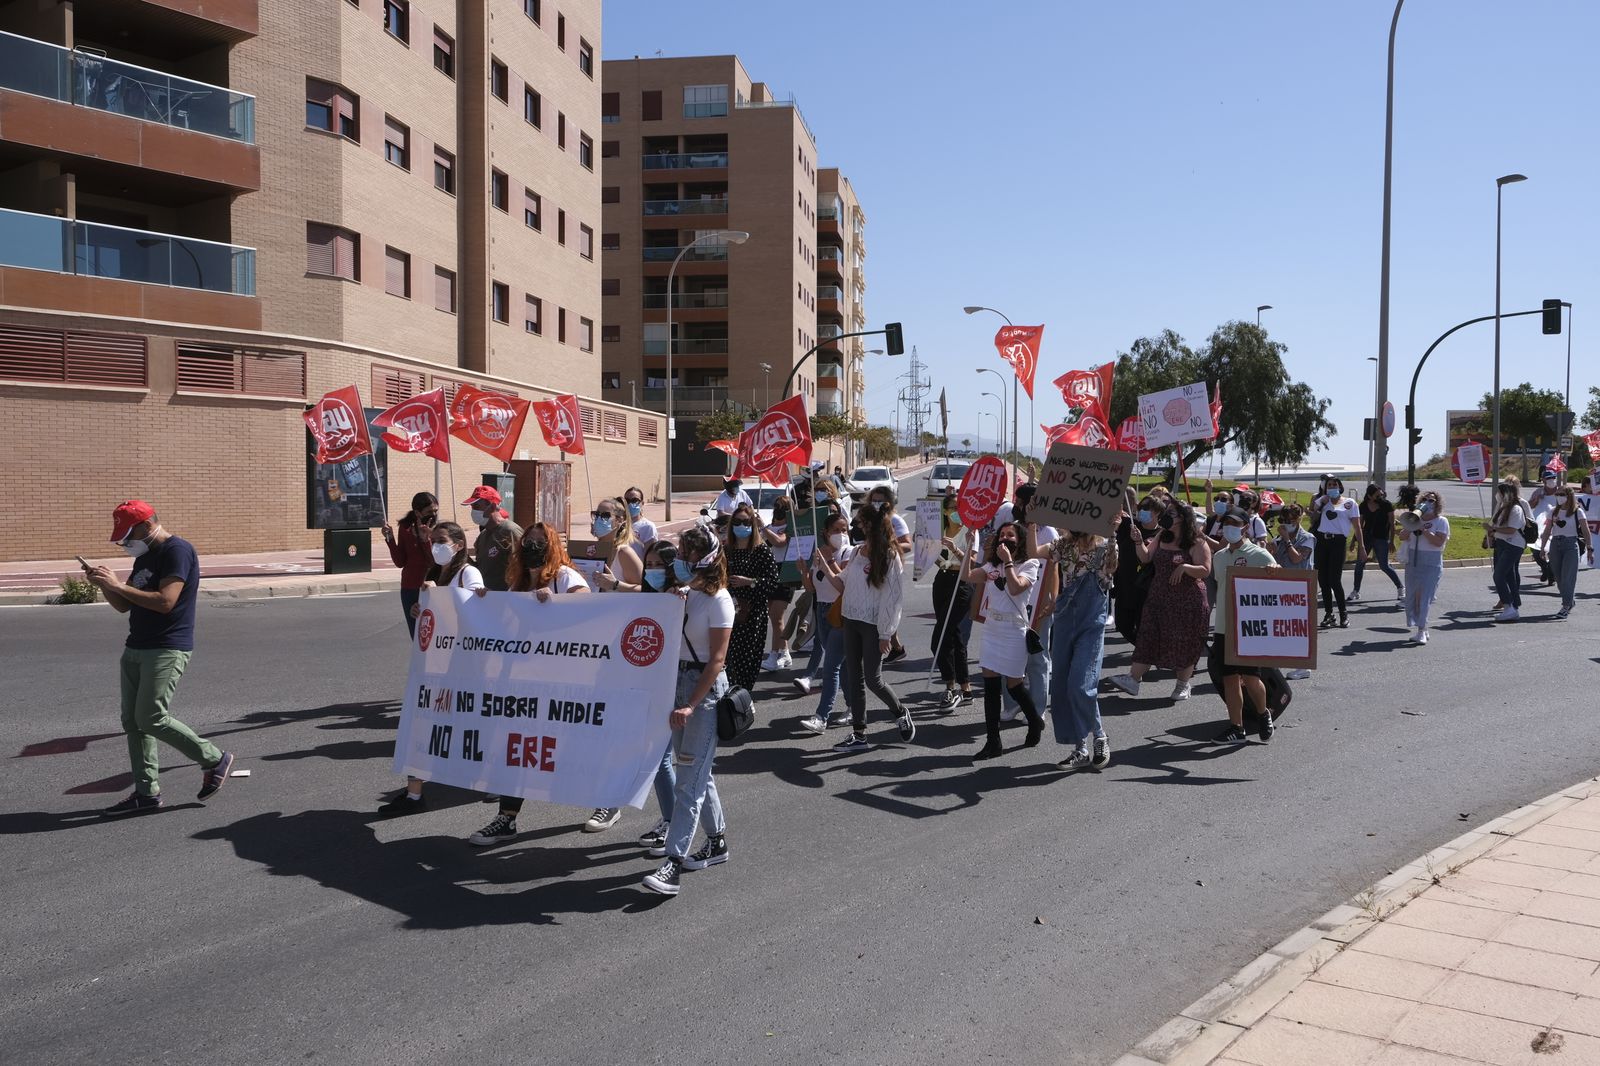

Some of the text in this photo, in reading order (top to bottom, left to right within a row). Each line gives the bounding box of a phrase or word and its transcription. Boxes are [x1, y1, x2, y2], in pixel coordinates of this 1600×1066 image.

[752, 418, 797, 455] UGT
[1049, 457, 1076, 467] NUEVOS
[1079, 461, 1109, 471] VALORES
[966, 463, 1005, 493] UGT
[1046, 470, 1123, 498] NO SOMOS
[1034, 496, 1049, 507] UN
[1240, 594, 1306, 606] NO NOS VAMOS
[633, 625, 654, 637] UGT
[1241, 619, 1308, 637] NOS ECHAN
[435, 635, 455, 649] UGT
[462, 636, 532, 654] COMERCIO
[534, 641, 611, 660] ALMERIA
[418, 685, 431, 708] EN
[456, 691, 474, 712] NO
[481, 692, 538, 718] SOBRA
[548, 699, 606, 726] NADIE
[428, 724, 557, 772] NO AL ERE
